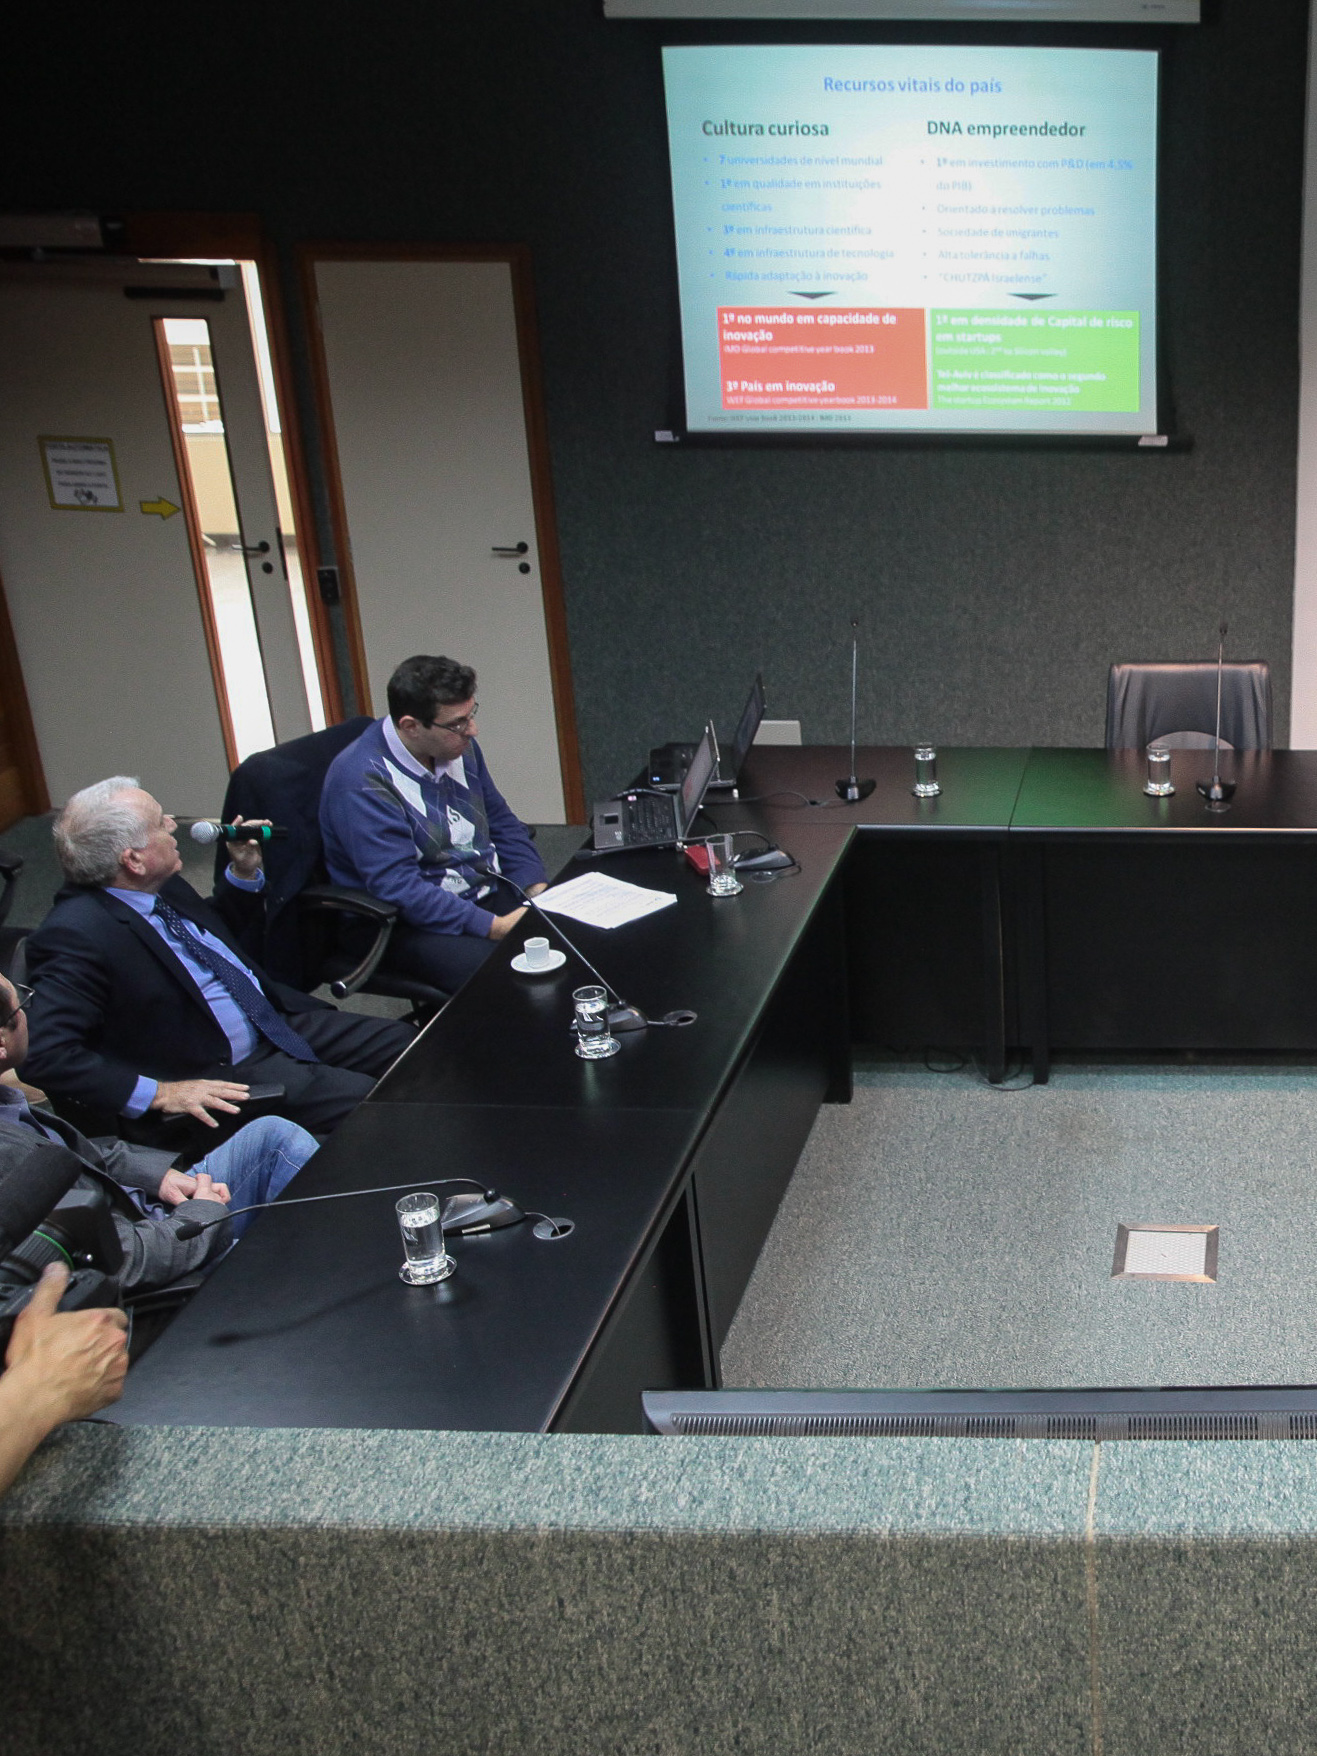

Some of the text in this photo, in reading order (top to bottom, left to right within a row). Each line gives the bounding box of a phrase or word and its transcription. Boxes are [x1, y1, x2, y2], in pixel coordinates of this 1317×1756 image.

[824, 77, 1003, 96] Recursos vitais do país
[702, 120, 829, 136] Cultura curiosa
[927, 120, 1085, 139] DNA empreendedor
[727, 154, 798, 165] universidades
[800, 154, 813, 165] de
[841, 154, 883, 165] mundial
[968, 157, 1035, 168] investimento
[1037, 160, 1058, 168] com
[734, 181, 750, 189] em
[752, 178, 801, 192] qualidade
[805, 181, 821, 189] em
[937, 205, 988, 214] Orientado
[998, 205, 1039, 215] resolver
[1041, 205, 1095, 217] problemas
[736, 227, 752, 235] em
[755, 225, 824, 235] infraestrutura
[937, 228, 989, 237] Sociedade
[991, 228, 1004, 237] de
[755, 249, 826, 259] infraestrutura
[827, 249, 839, 259] de
[841, 249, 895, 262] tecnologia
[738, 315, 752, 324] no
[754, 313, 794, 324] mundo
[797, 316, 814, 324] em
[817, 313, 879, 326] capacidade
[882, 313, 897, 325] de
[951, 318, 968, 326] em
[971, 315, 1027, 326] densidade
[1031, 315, 1044, 327] de
[1048, 316, 1087, 329] Capital
[1089, 316, 1103, 327] de
[1106, 316, 1133, 328] risco
[722, 330, 773, 344] inovação
[936, 332, 1001, 344] em startups
[741, 380, 763, 392] País
[765, 384, 783, 392] em
[785, 380, 835, 394] inovação
